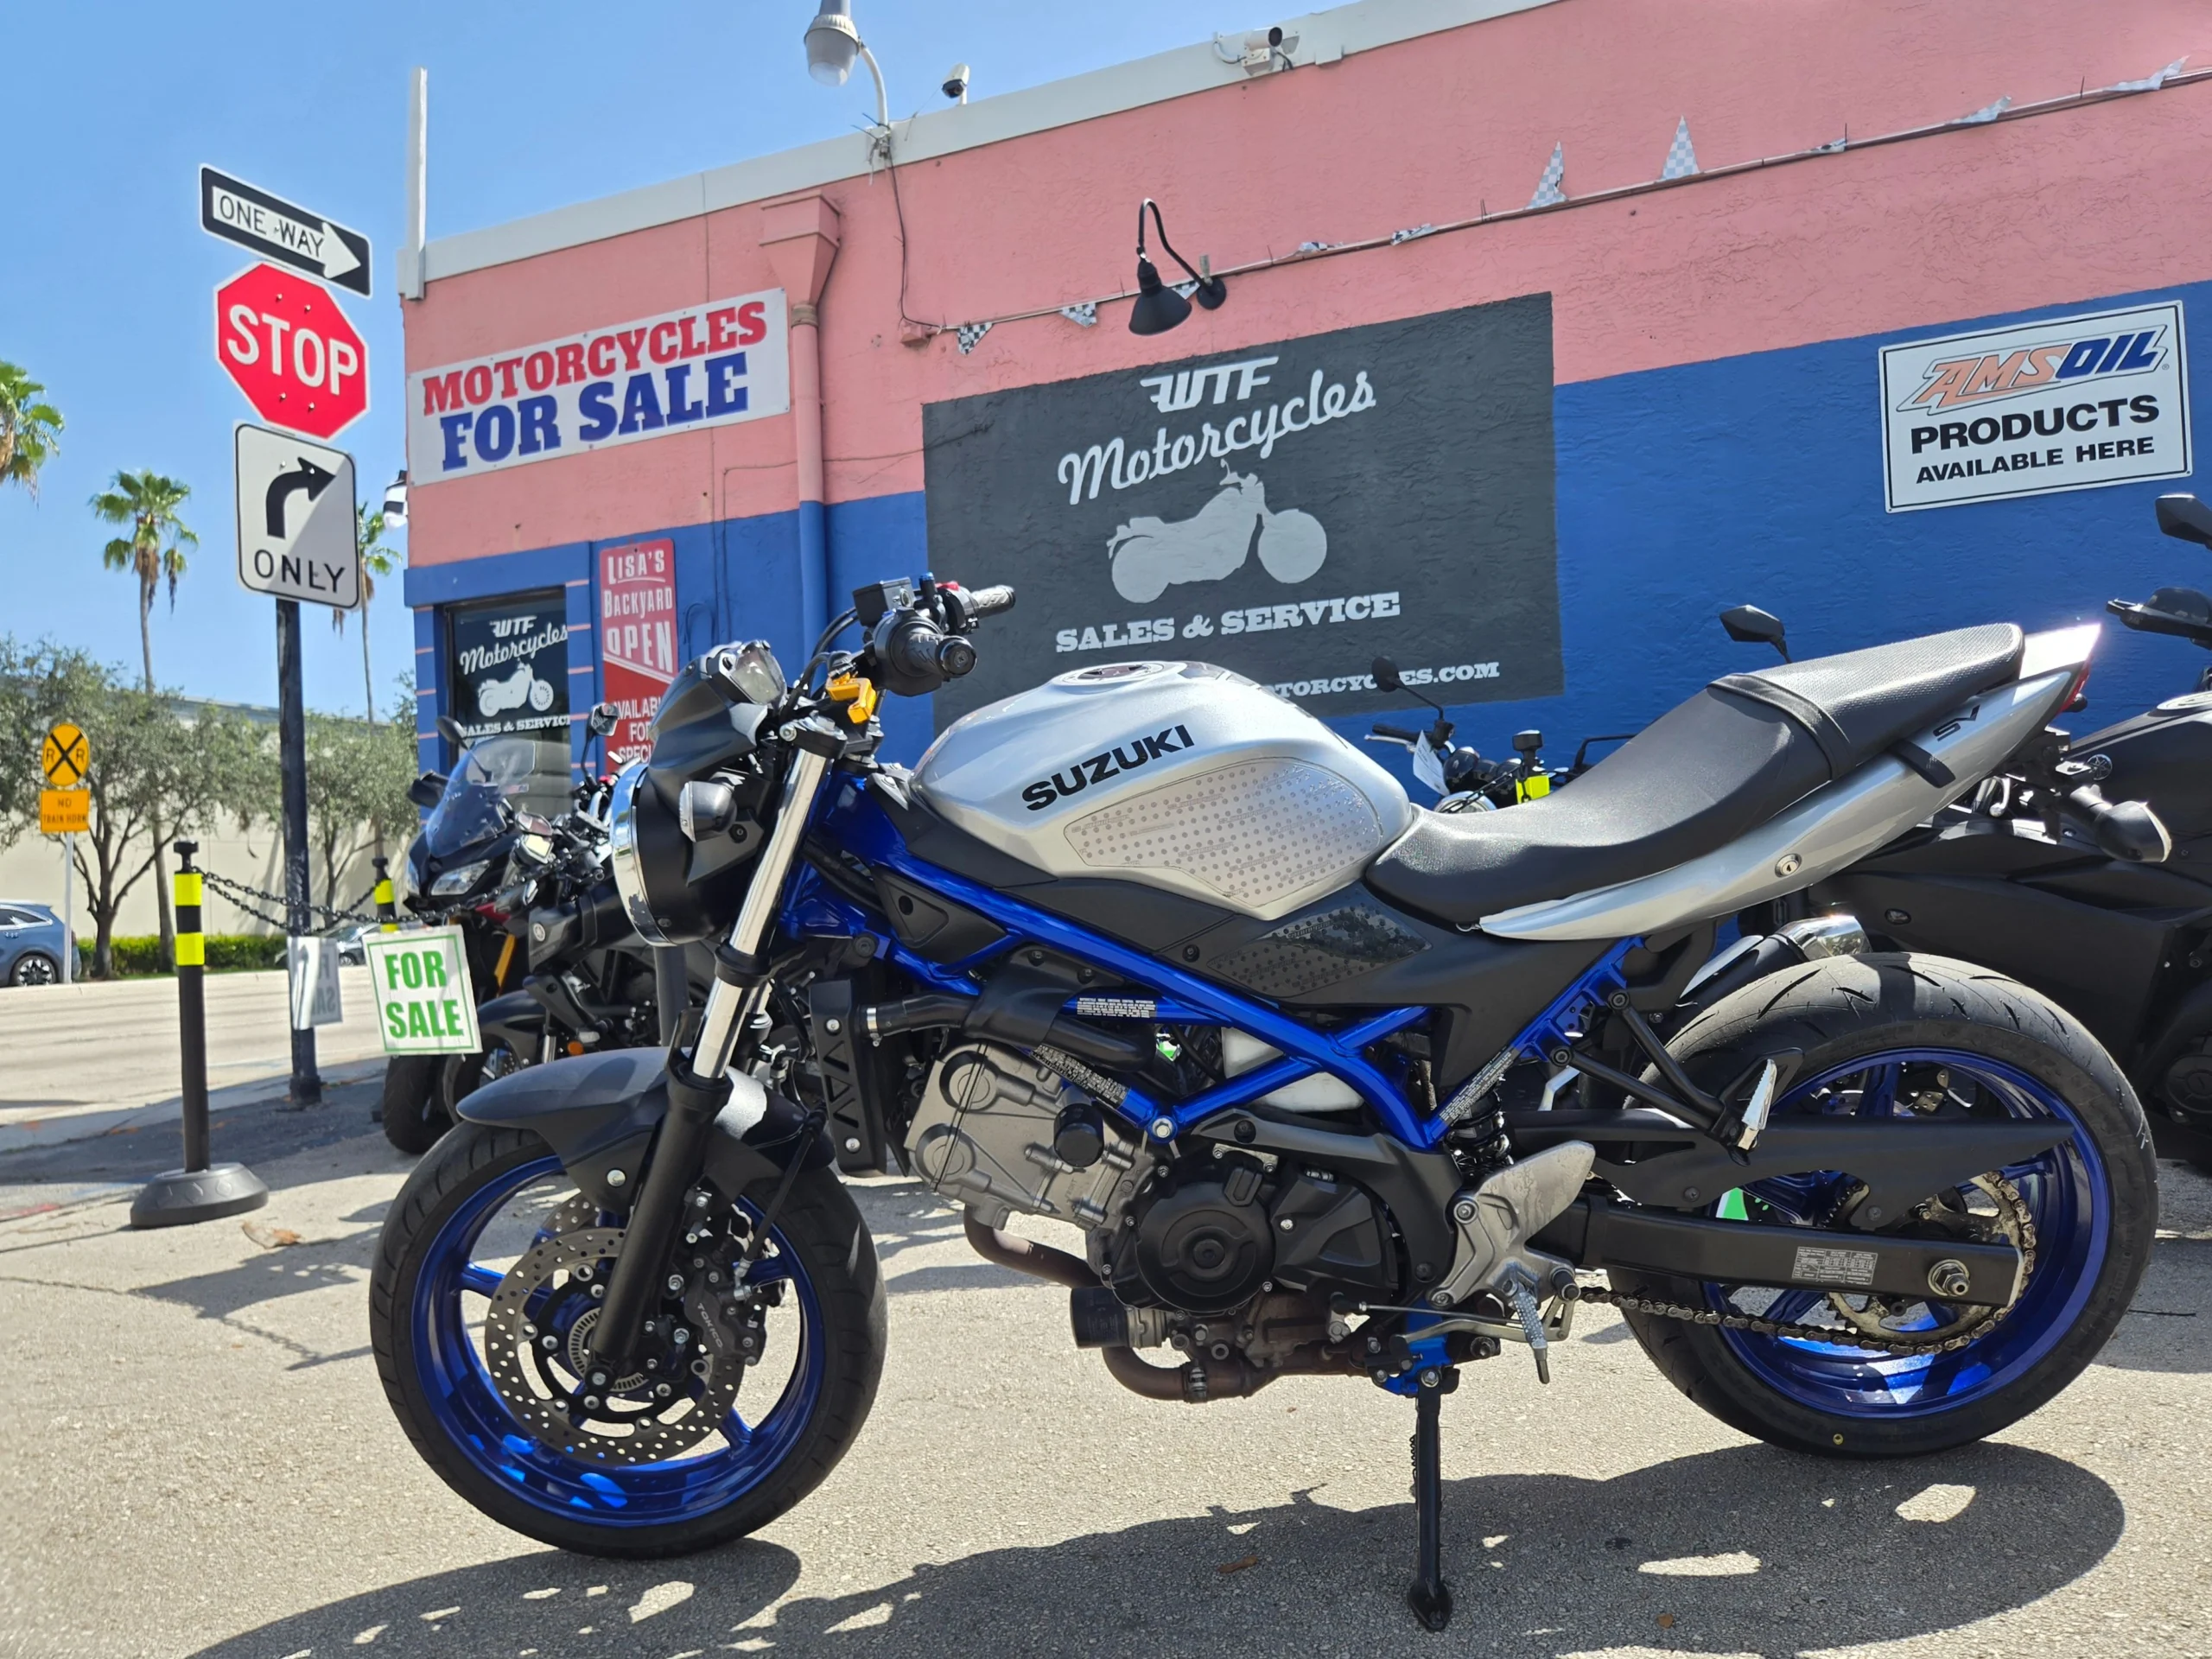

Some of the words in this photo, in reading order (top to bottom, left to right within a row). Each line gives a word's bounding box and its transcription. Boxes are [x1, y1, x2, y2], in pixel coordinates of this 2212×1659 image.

[219, 194, 267, 236] ONE
[276, 219, 325, 258] WAY
[227, 304, 359, 396] STOP
[423, 300, 767, 416] MOTORCYCLES
[1911, 329, 2158, 409] AMSOIL
[440, 394, 562, 472] FOR
[578, 351, 748, 442] SALE
[1140, 356, 1280, 413] WTF
[1057, 369, 1378, 506] Motorcycles
[1910, 394, 2159, 454] PRODUCTS
[1916, 448, 2063, 485] AVAILABLE
[2075, 436, 2155, 463] HERE
[254, 550, 346, 594] ONLY
[608, 550, 664, 584] LISA'S
[459, 622, 569, 676] Motorcycles
[489, 615, 537, 638] WTF
[607, 620, 673, 674] OPEN
[1055, 614, 1175, 654] SALES
[1181, 613, 1214, 639] &
[1220, 591, 1401, 636] SERVICE
[504, 721, 514, 732] &
[1932, 704, 1980, 741] SV
[1021, 724, 1195, 811] SUZUKI
[385, 950, 448, 990] FOR
[385, 999, 465, 1039] SALE
[697, 1302, 724, 1348] TOKICO
